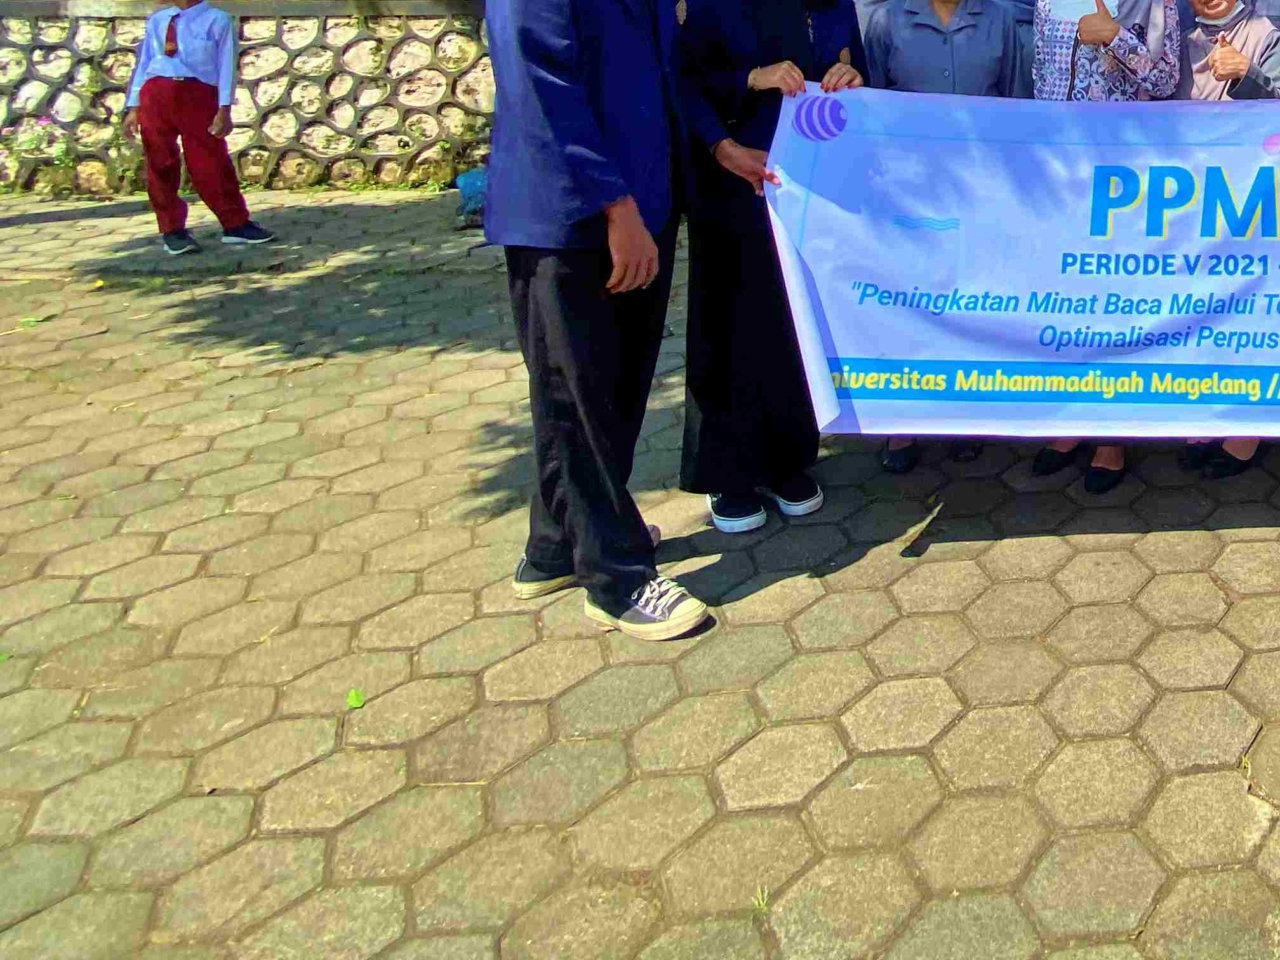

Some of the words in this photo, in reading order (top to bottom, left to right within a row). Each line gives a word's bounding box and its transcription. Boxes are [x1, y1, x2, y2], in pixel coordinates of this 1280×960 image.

[1062, 253, 1177, 276] PERIODE
[1182, 254, 1201, 276] V
[1208, 254, 1270, 276] 2021
[851, 281, 1020, 316] "Peningkatan
[1026, 293, 1098, 315] Minat
[1103, 294, 1162, 316] Baca
[1168, 293, 1257, 316] Melalui
[1038, 325, 1191, 352] Optimalisasi
[831, 365, 948, 391] niversitas
[954, 369, 1145, 400] Muhammadiyah
[1150, 372, 1262, 401] Magelang
